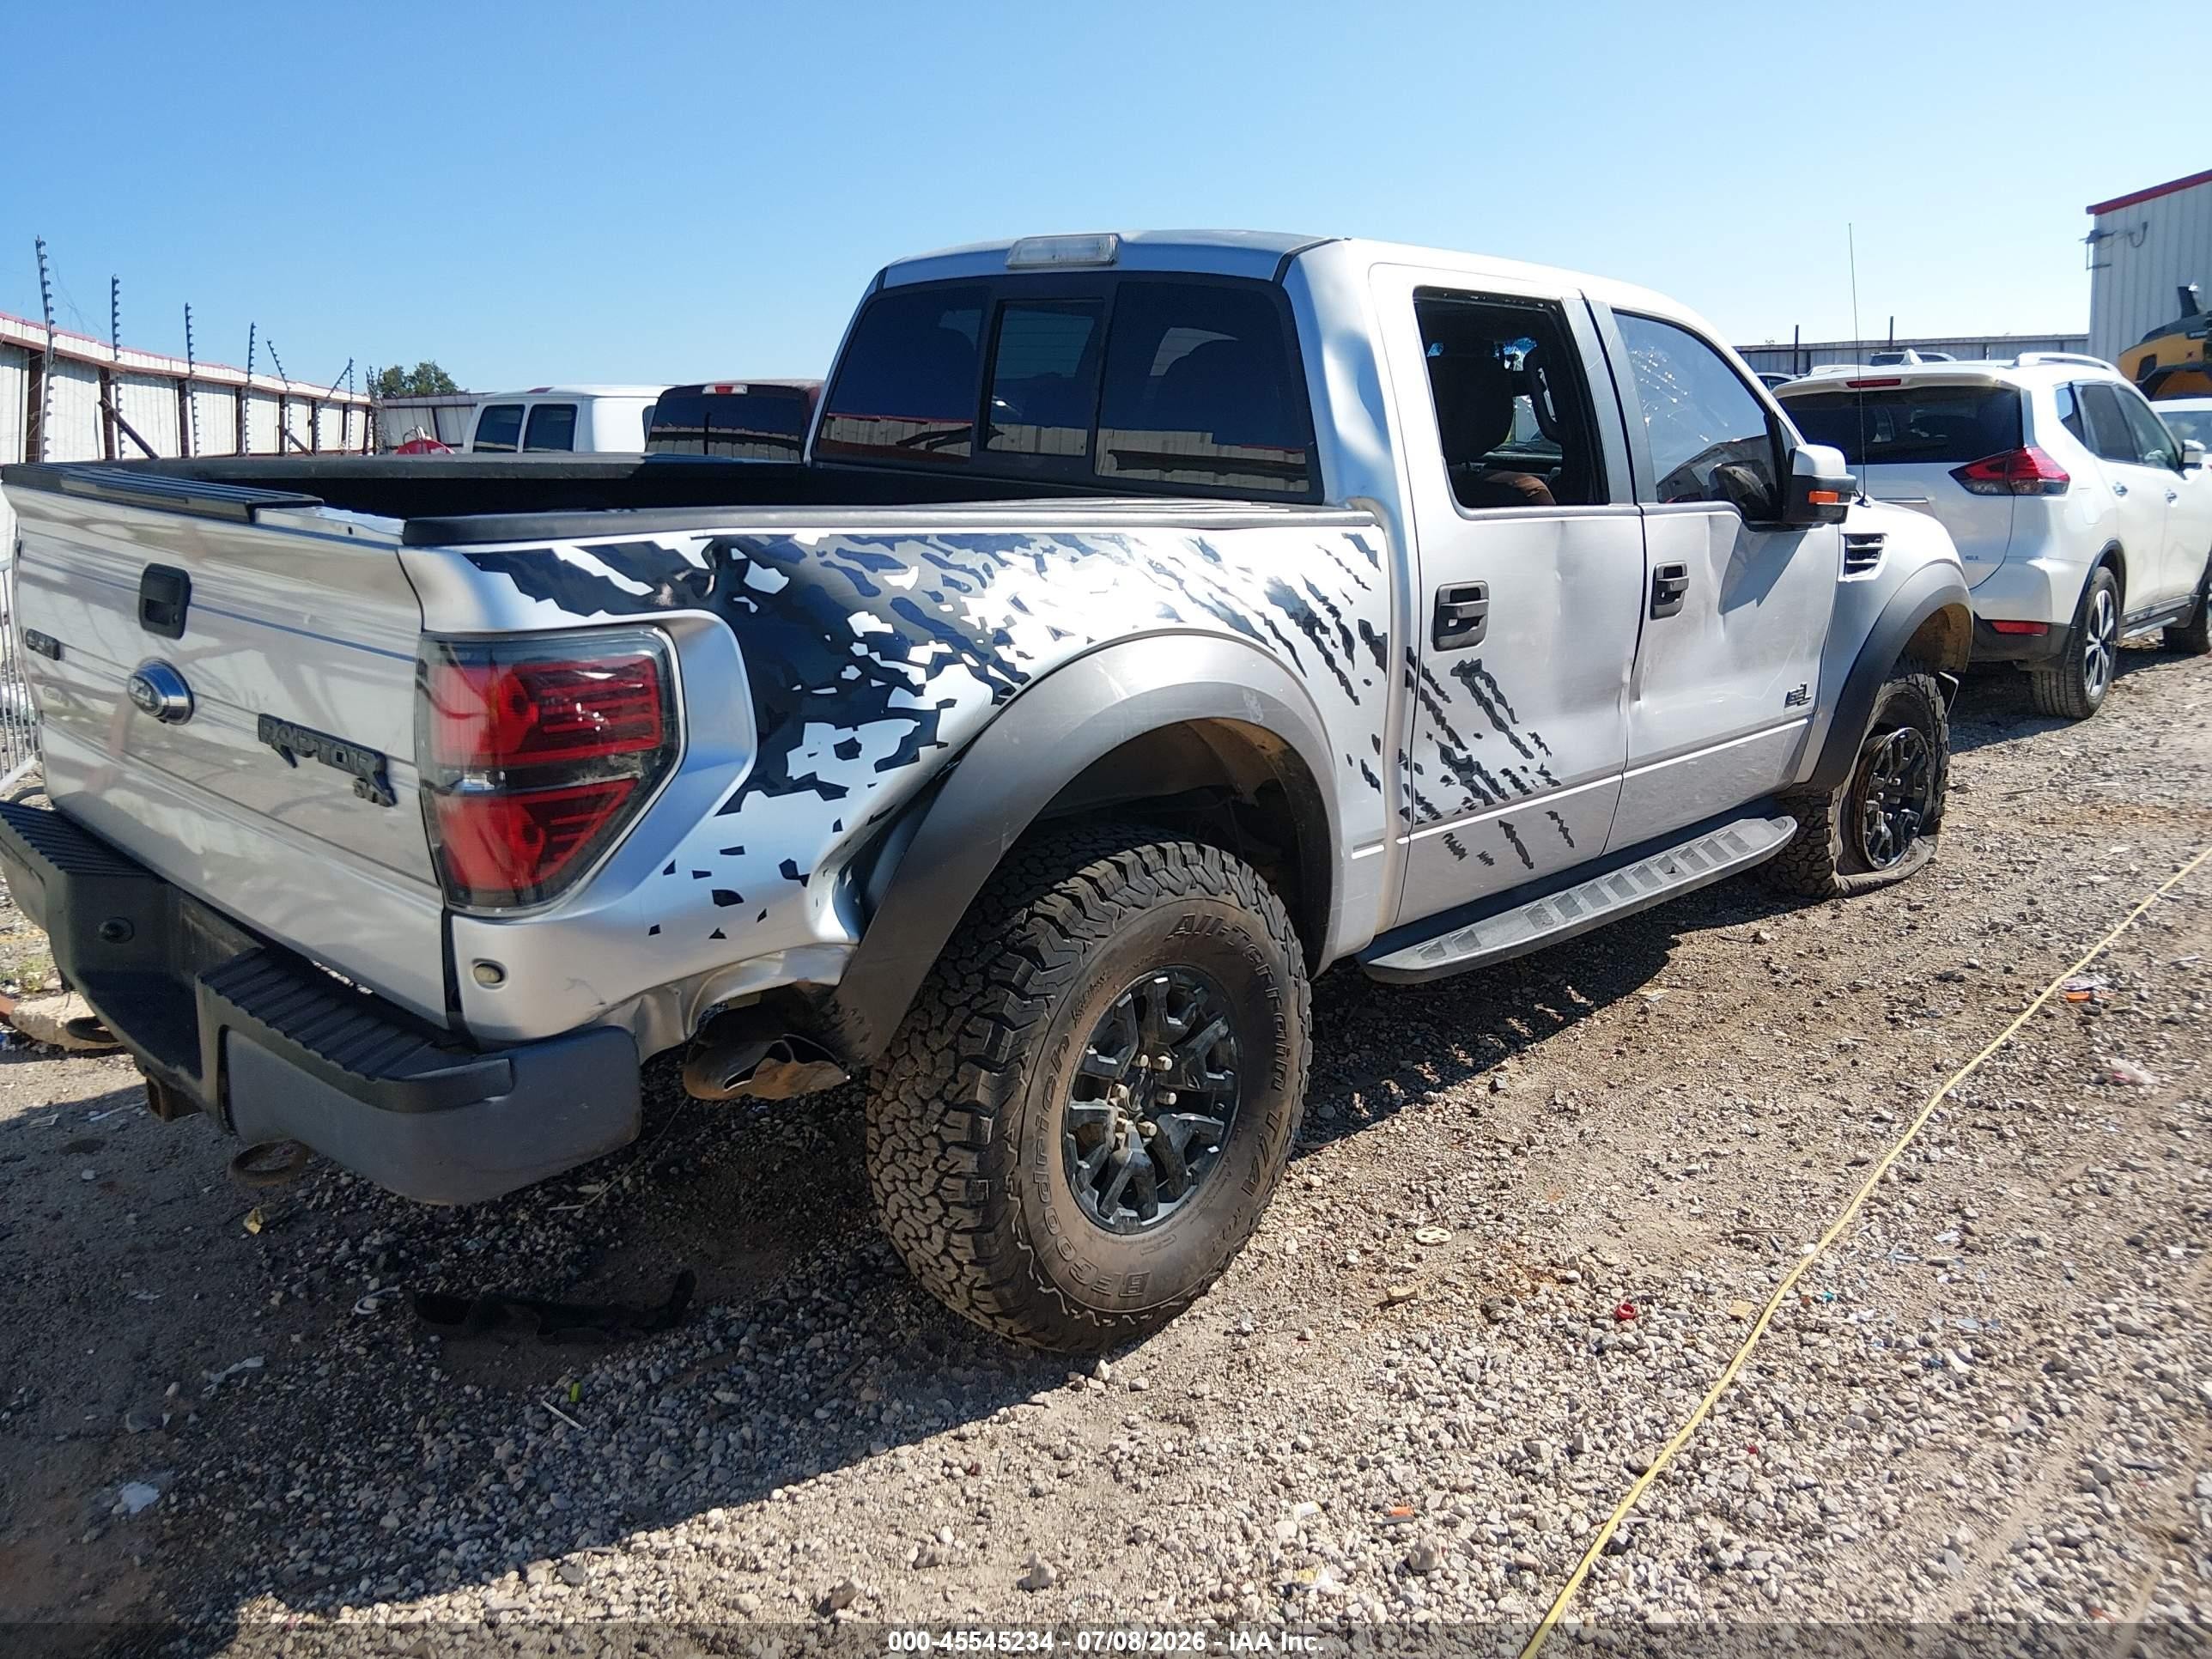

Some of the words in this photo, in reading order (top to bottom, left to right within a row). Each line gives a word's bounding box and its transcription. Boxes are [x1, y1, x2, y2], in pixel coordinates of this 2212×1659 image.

[258, 714, 398, 807] RAPTOR
[1033, 1033, 1151, 1297] BFGoodrich
[1164, 913, 1289, 1091] All-Terrain
[1241, 1111, 1285, 1197] T/A
